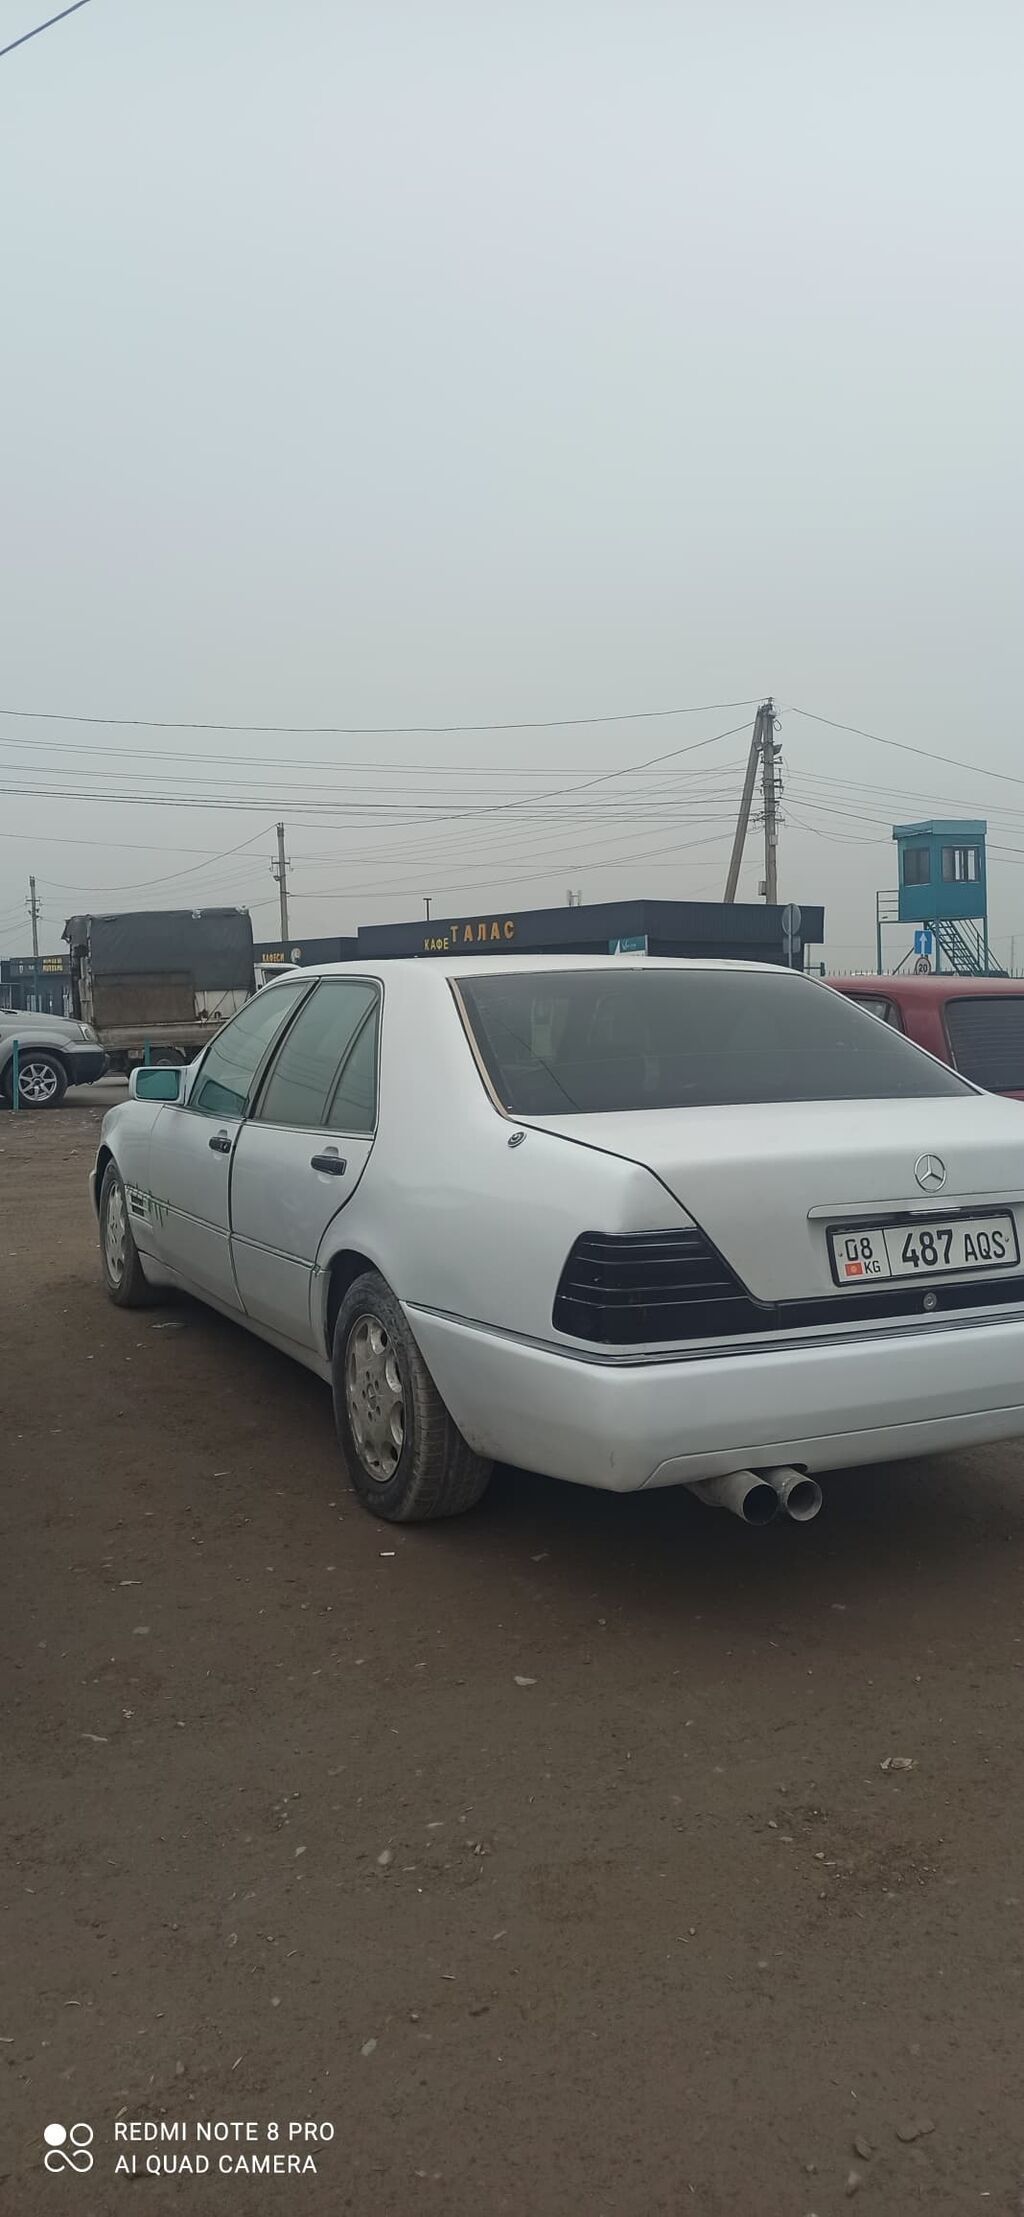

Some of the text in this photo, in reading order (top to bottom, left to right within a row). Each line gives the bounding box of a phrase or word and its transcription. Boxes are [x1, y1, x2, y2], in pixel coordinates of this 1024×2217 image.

[424, 920, 515, 951] КАФЕ ТАЛАС
[918, 963, 928, 973] 20
[845, 1229, 1006, 1268] 08 487 AQS
[864, 1260, 881, 1275] KG
